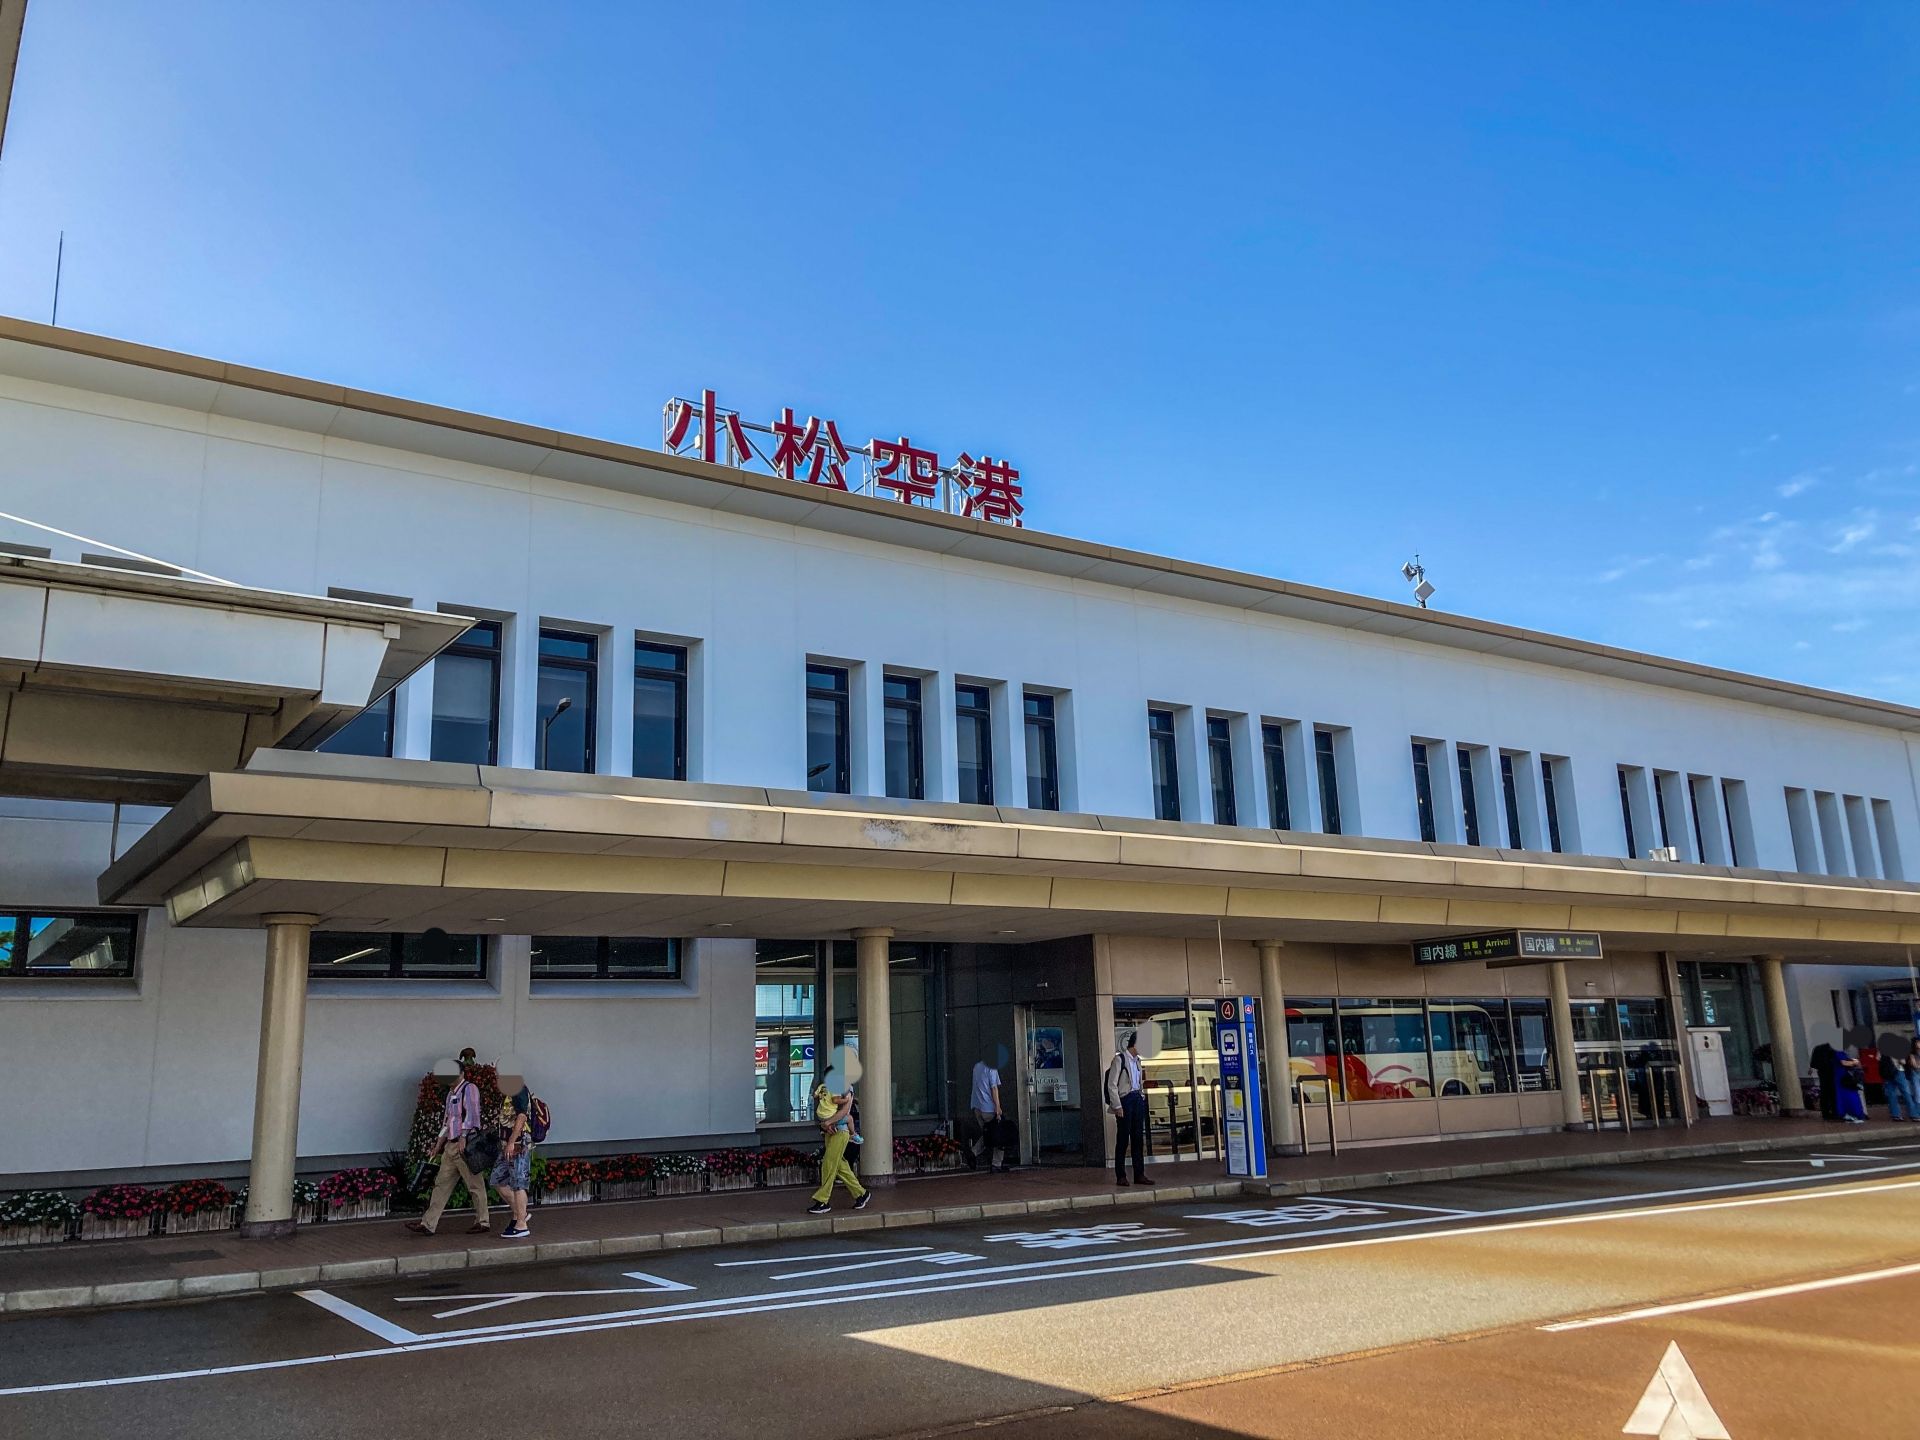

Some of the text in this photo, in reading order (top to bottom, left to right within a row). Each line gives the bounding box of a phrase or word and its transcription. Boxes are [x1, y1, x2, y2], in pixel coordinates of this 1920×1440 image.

[666, 388, 1024, 528] 小松空港
[1485, 937, 1511, 948] Arrival
[1525, 937, 1556, 953] 国内線
[1420, 944, 1458, 961] 国内線
[1224, 1004, 1231, 1017] 4
